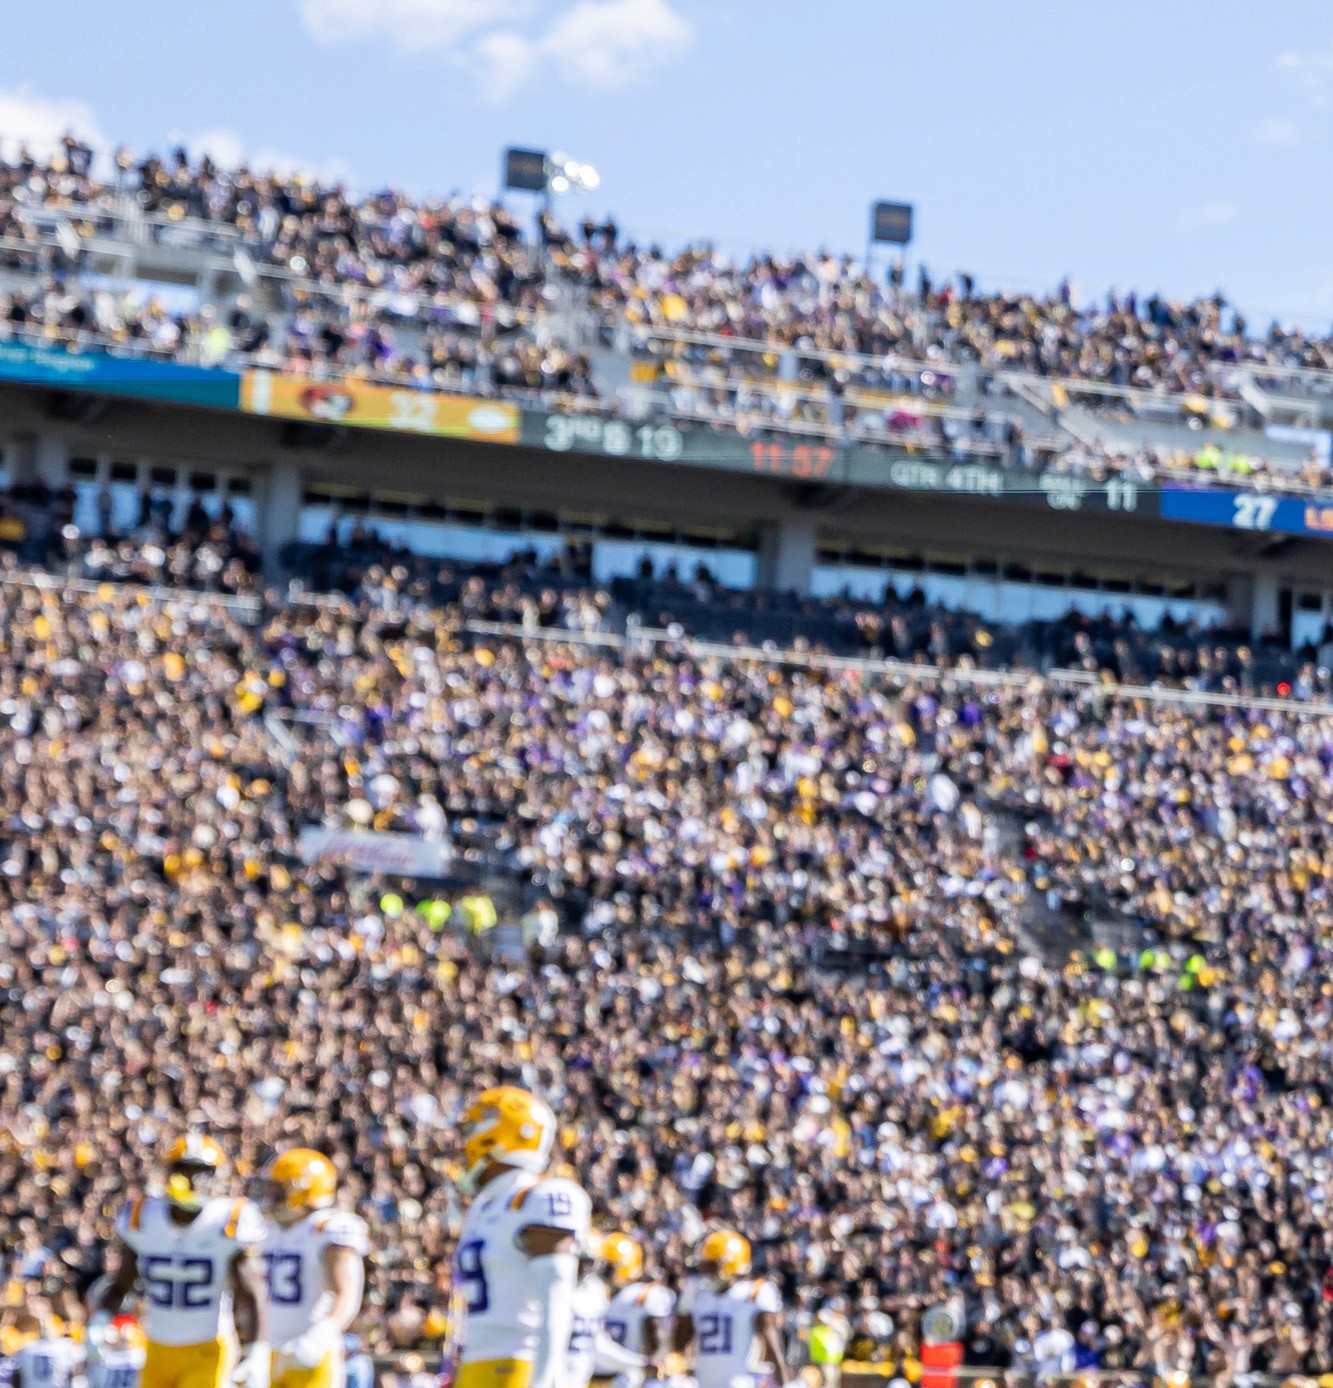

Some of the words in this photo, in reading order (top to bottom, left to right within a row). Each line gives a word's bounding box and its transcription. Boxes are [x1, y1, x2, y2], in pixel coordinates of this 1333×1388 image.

[1232, 493, 1278, 531] 27
[146, 1255, 212, 1308] 52
[699, 1313, 733, 1355] 21
